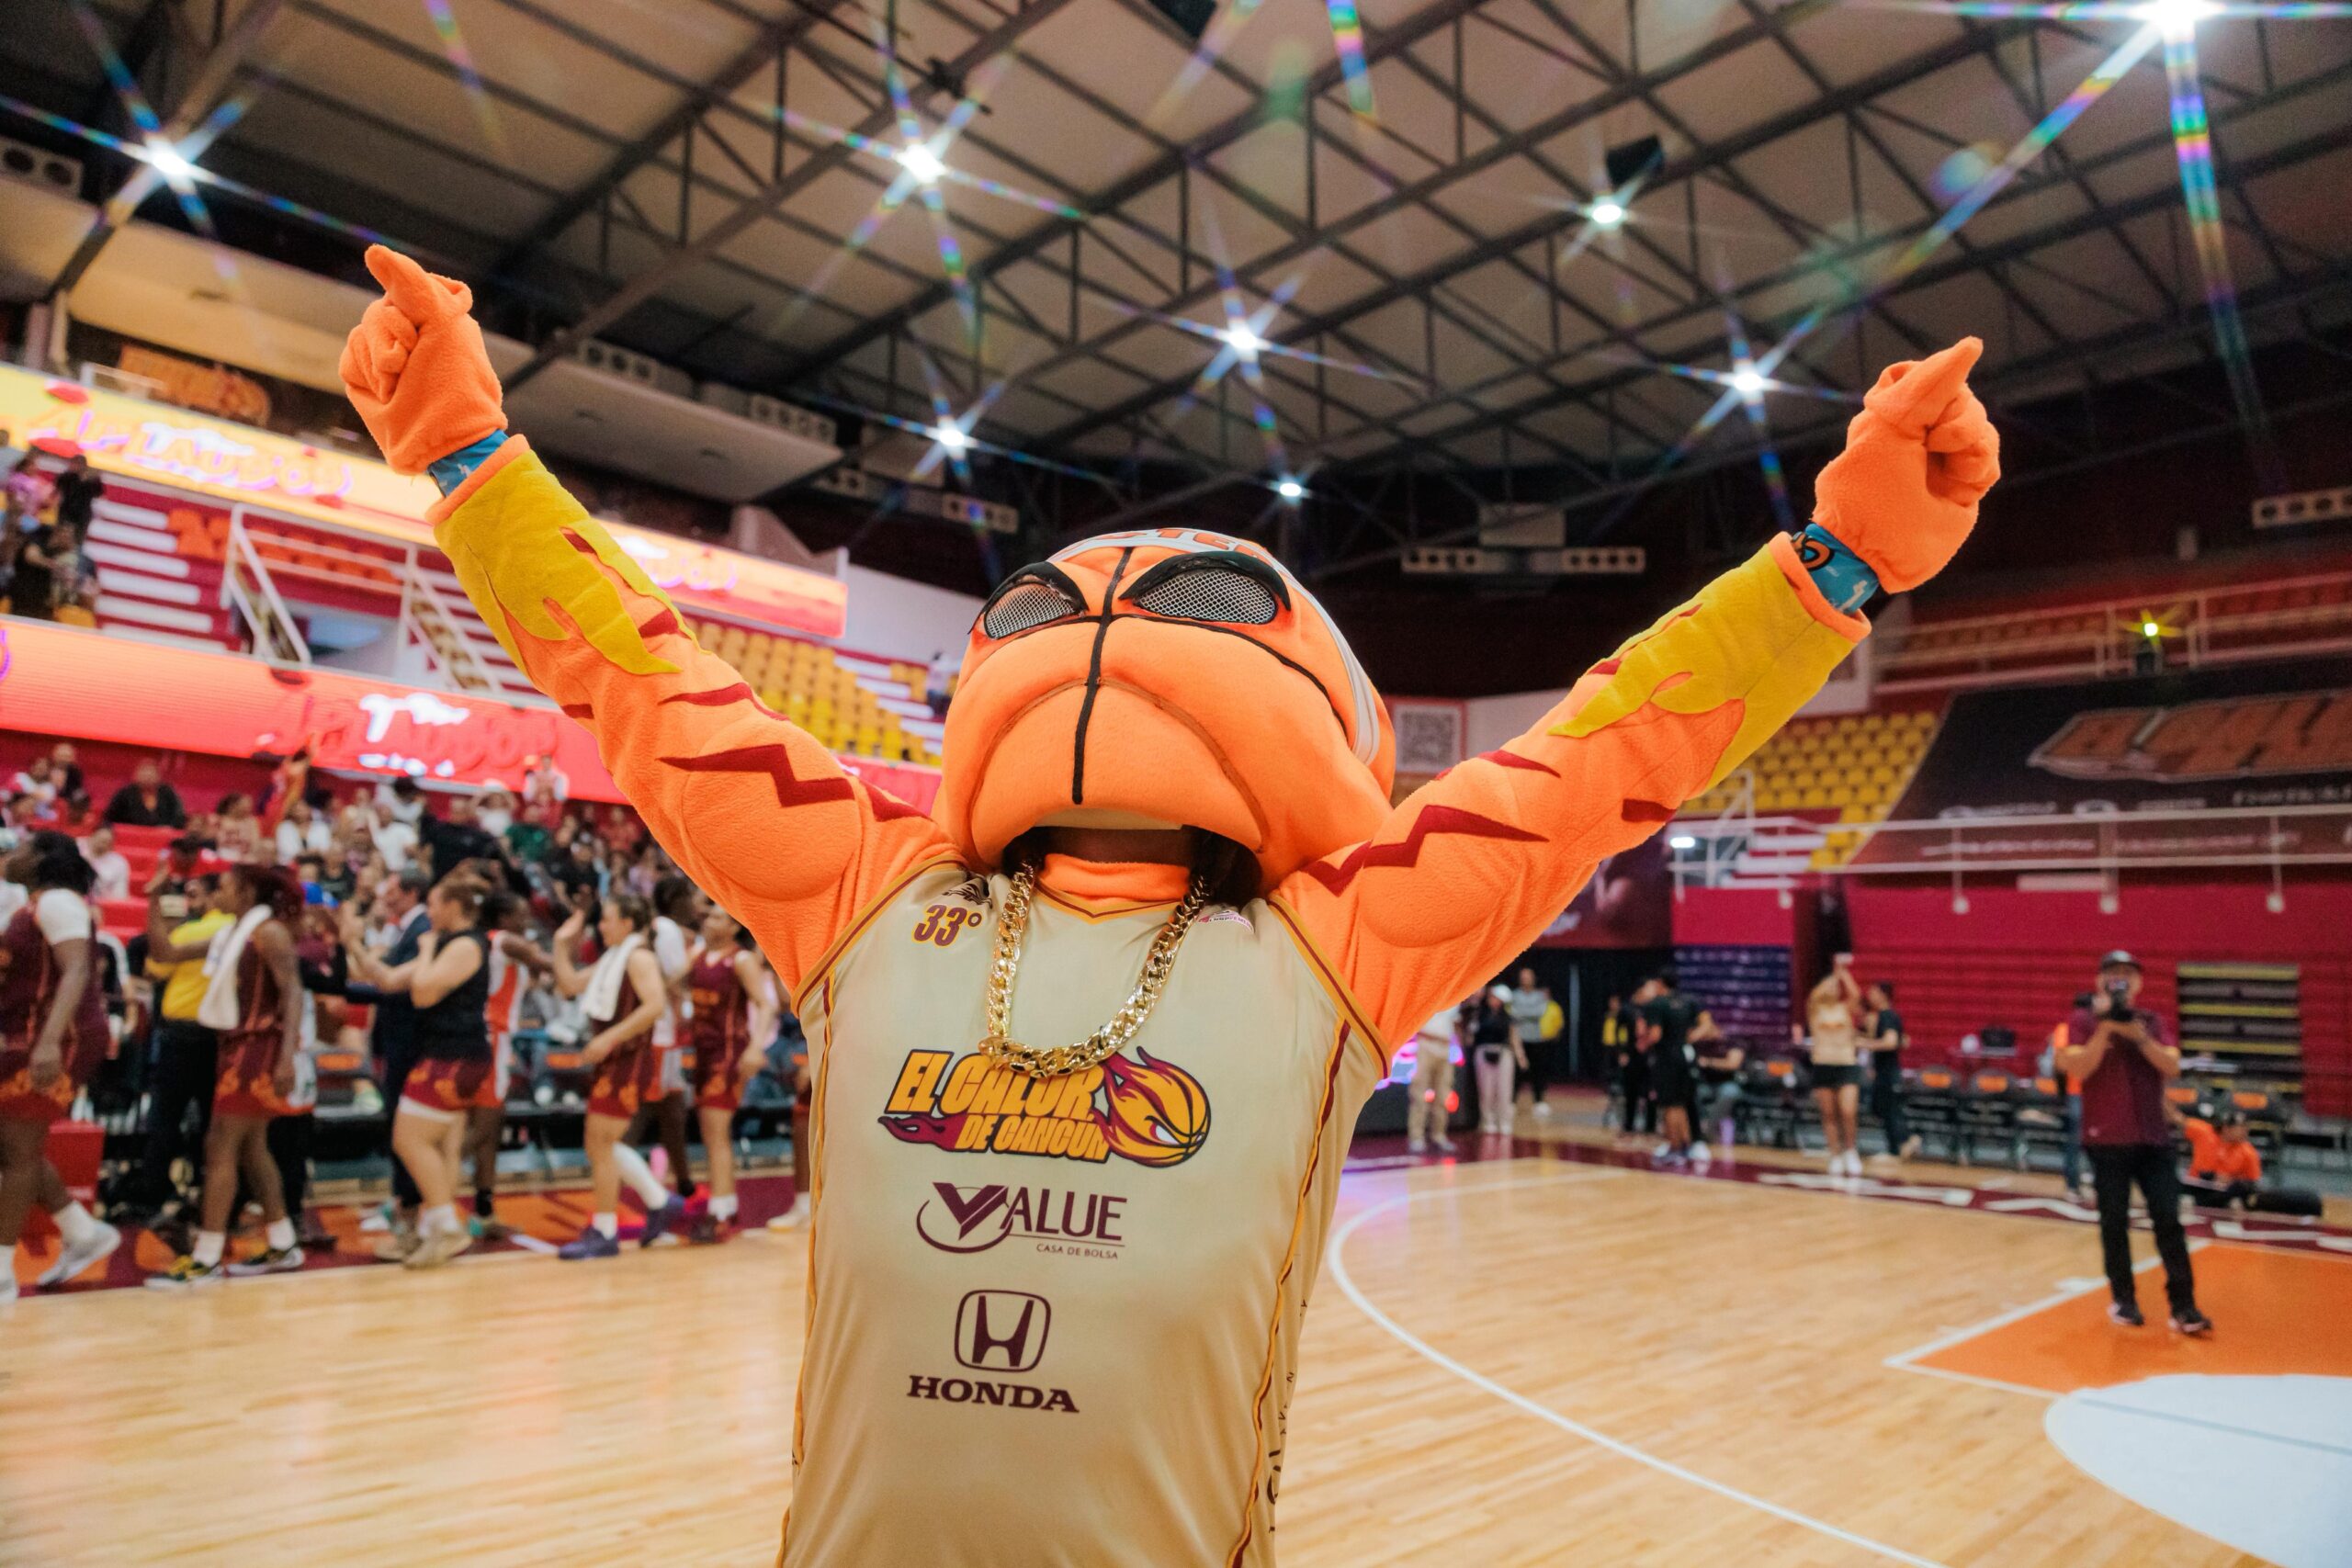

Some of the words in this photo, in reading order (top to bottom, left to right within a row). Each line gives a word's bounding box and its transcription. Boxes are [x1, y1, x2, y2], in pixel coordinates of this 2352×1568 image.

[885, 1050, 954, 1114] EL
[954, 1113, 1000, 1150] DE
[933, 1181, 1128, 1241] VALUE
[1036, 1243, 1064, 1254] CASA
[1067, 1247, 1081, 1257] DE
[1084, 1248, 1118, 1259] BOLSA
[906, 1375, 1080, 1413] HONDA
